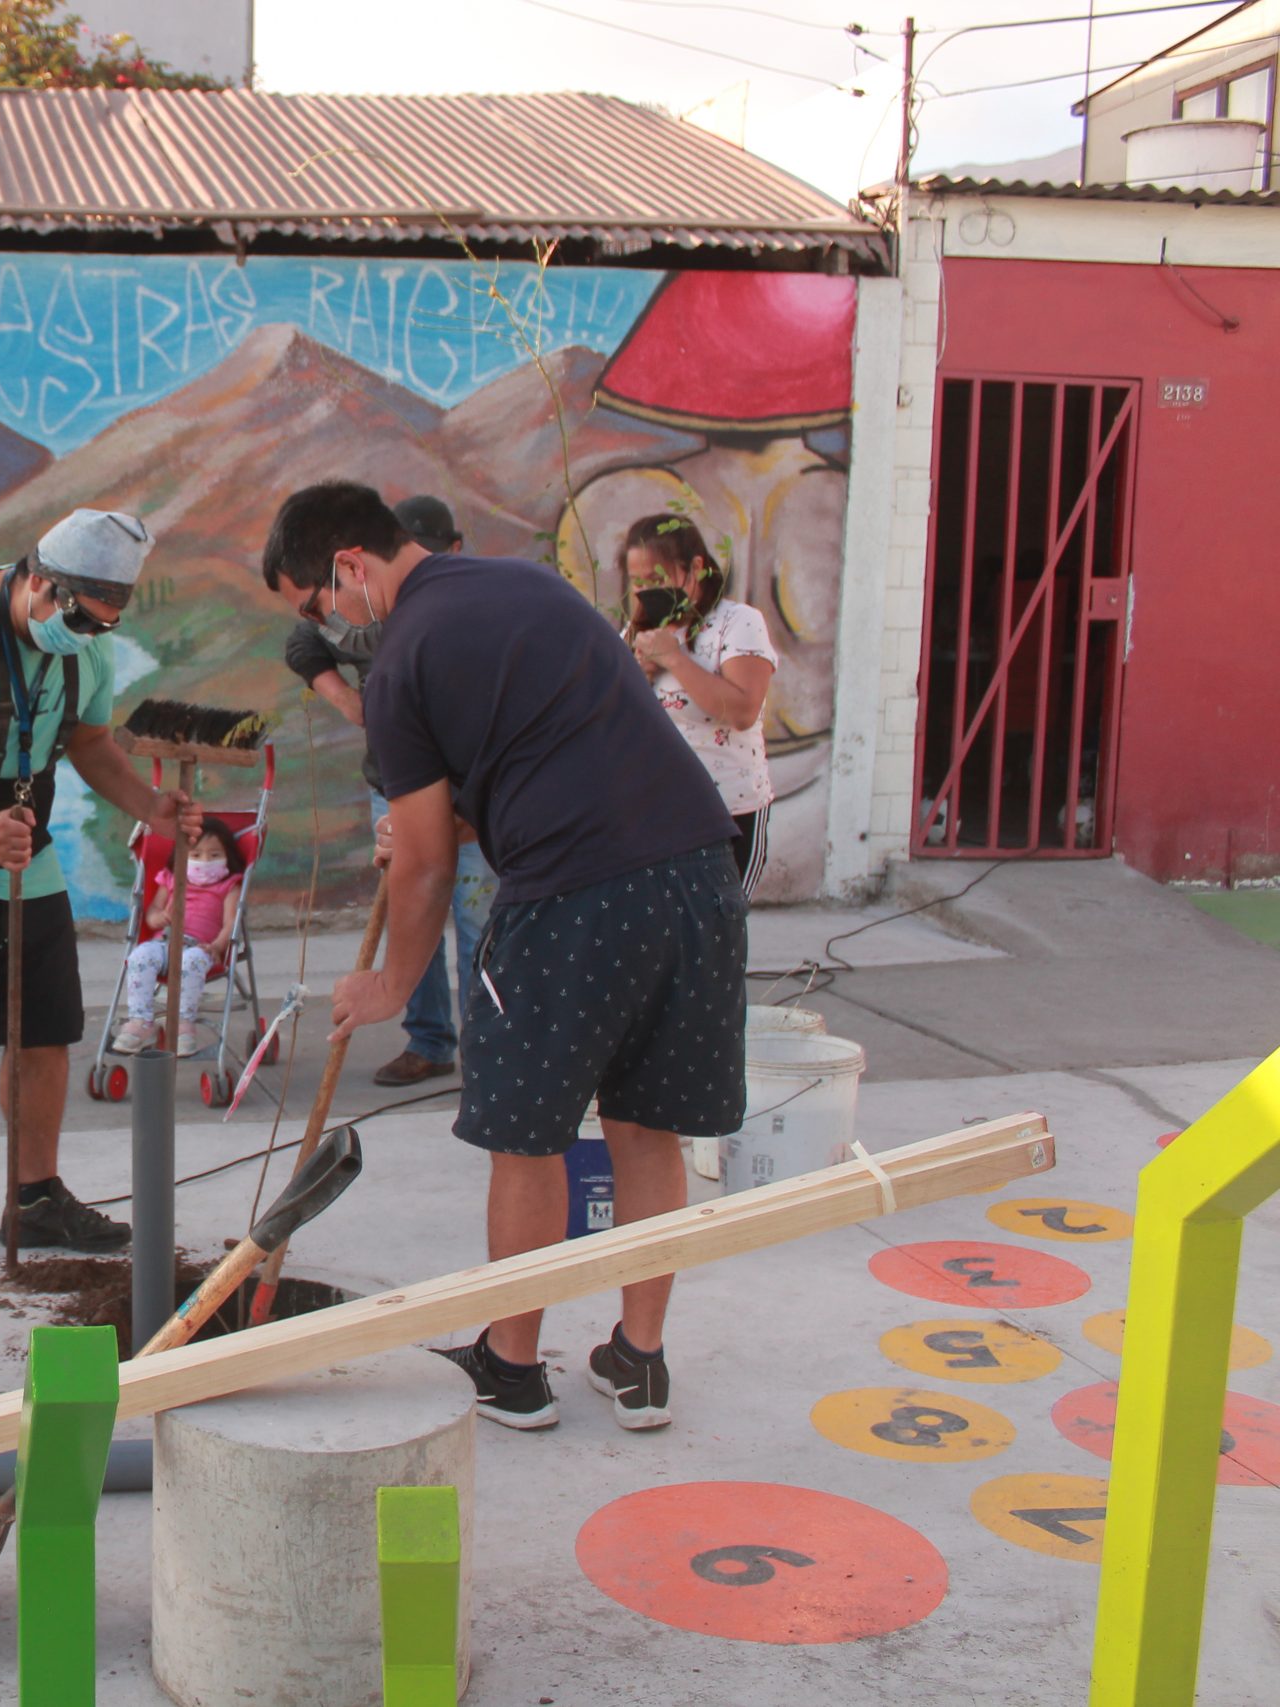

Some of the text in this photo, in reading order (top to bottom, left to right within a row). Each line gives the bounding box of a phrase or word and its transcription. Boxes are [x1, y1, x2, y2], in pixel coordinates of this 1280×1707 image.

[1163, 384, 1203, 402] 2138
[942, 1257, 1020, 1287] 3
[923, 1330, 1001, 1368] 5
[870, 1406, 969, 1446] 8
